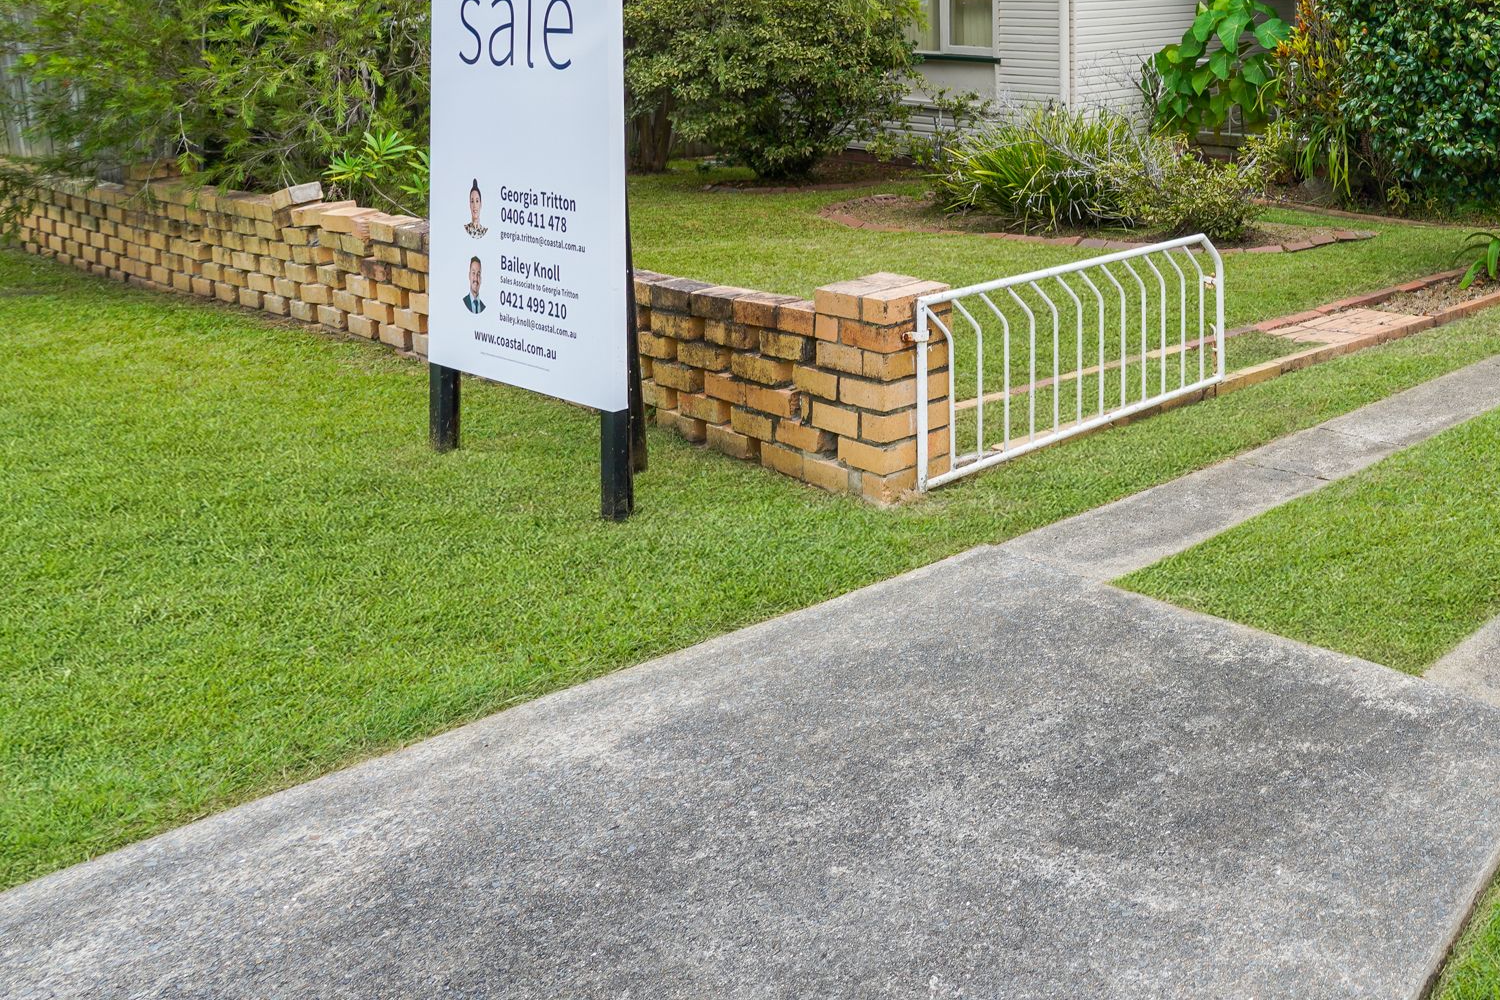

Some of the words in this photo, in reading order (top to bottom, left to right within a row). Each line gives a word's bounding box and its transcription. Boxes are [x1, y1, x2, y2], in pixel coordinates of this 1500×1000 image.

[500, 185, 538, 209] Georgia
[540, 191, 576, 212] Tritton
[500, 207, 525, 226] 0406
[527, 211, 546, 229] 411
[548, 215, 567, 233] 478
[500, 231, 586, 253] georgia.tritton@coastal.com.au
[500, 255, 531, 279] Bailey
[533, 261, 560, 282] Knoll
[500, 275, 513, 286] Sales
[513, 278, 536, 291] Associate
[536, 283, 542, 292] to
[542, 284, 561, 297] Georgia
[561, 288, 579, 300] Tritton
[500, 290, 524, 310] 0421
[526, 296, 545, 315] 499
[547, 300, 567, 320] 210
[499, 312, 577, 339] bailey.knoll@coastal.com.au
[474, 329, 557, 361] www.coastal.com.au
